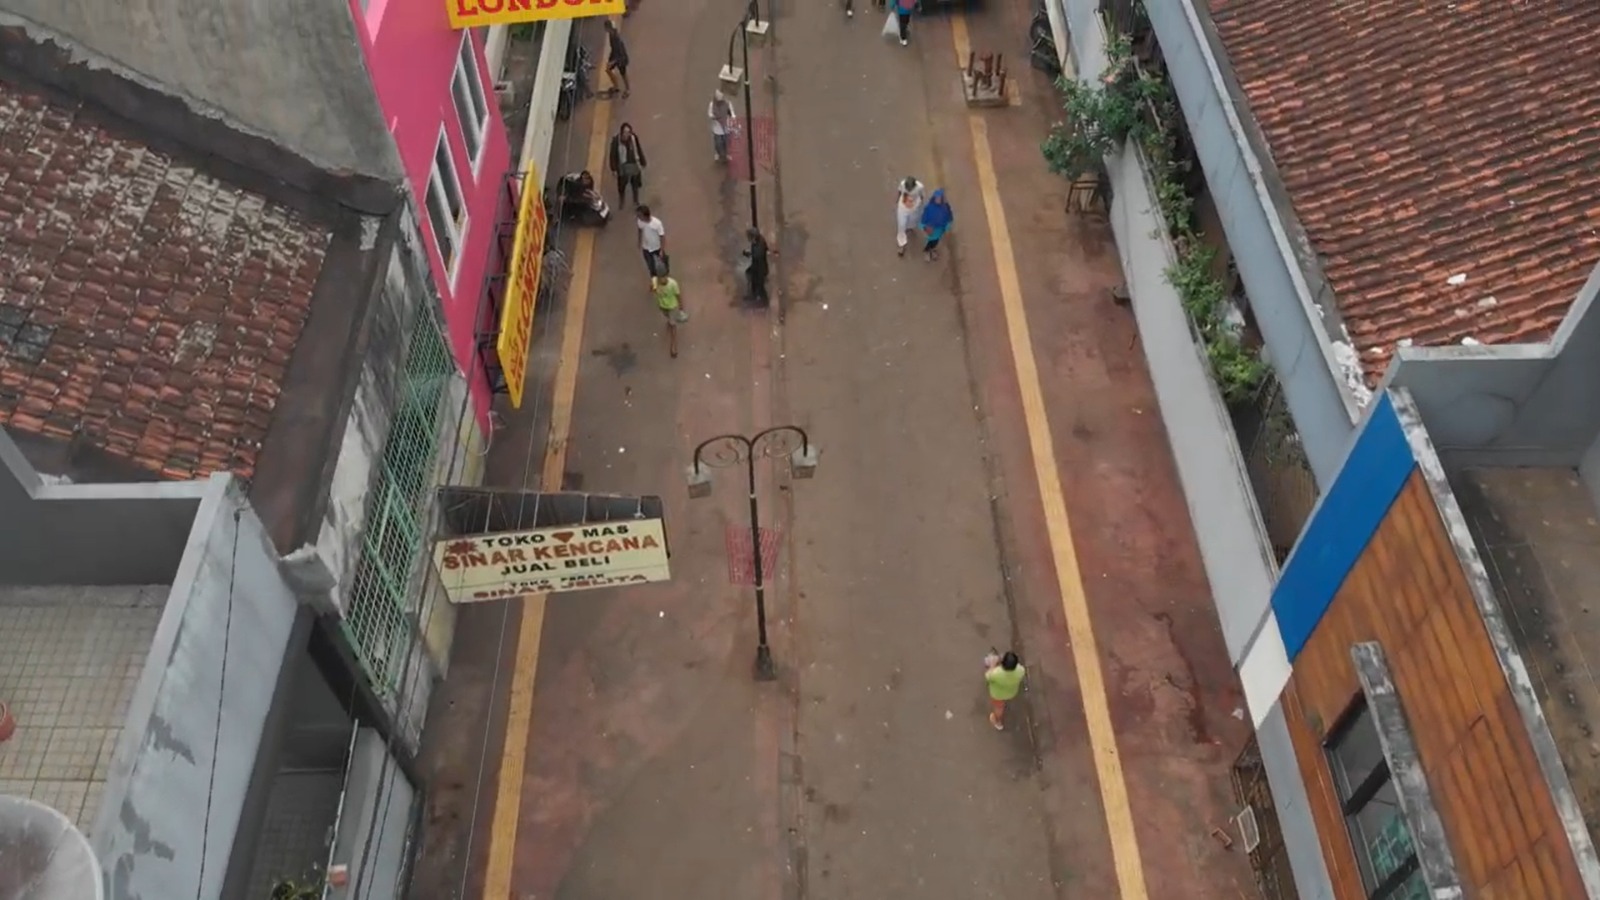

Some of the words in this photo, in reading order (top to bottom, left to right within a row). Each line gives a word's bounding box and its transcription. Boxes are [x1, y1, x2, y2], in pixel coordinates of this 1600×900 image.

[482, 534, 545, 548] TOKO
[583, 525, 629, 539] MAS
[443, 549, 528, 570] SINAR
[534, 534, 659, 561] KENCANA
[501, 560, 556, 576] JUAL
[564, 556, 611, 568] BELI
[473, 585, 556, 599] SINAR
